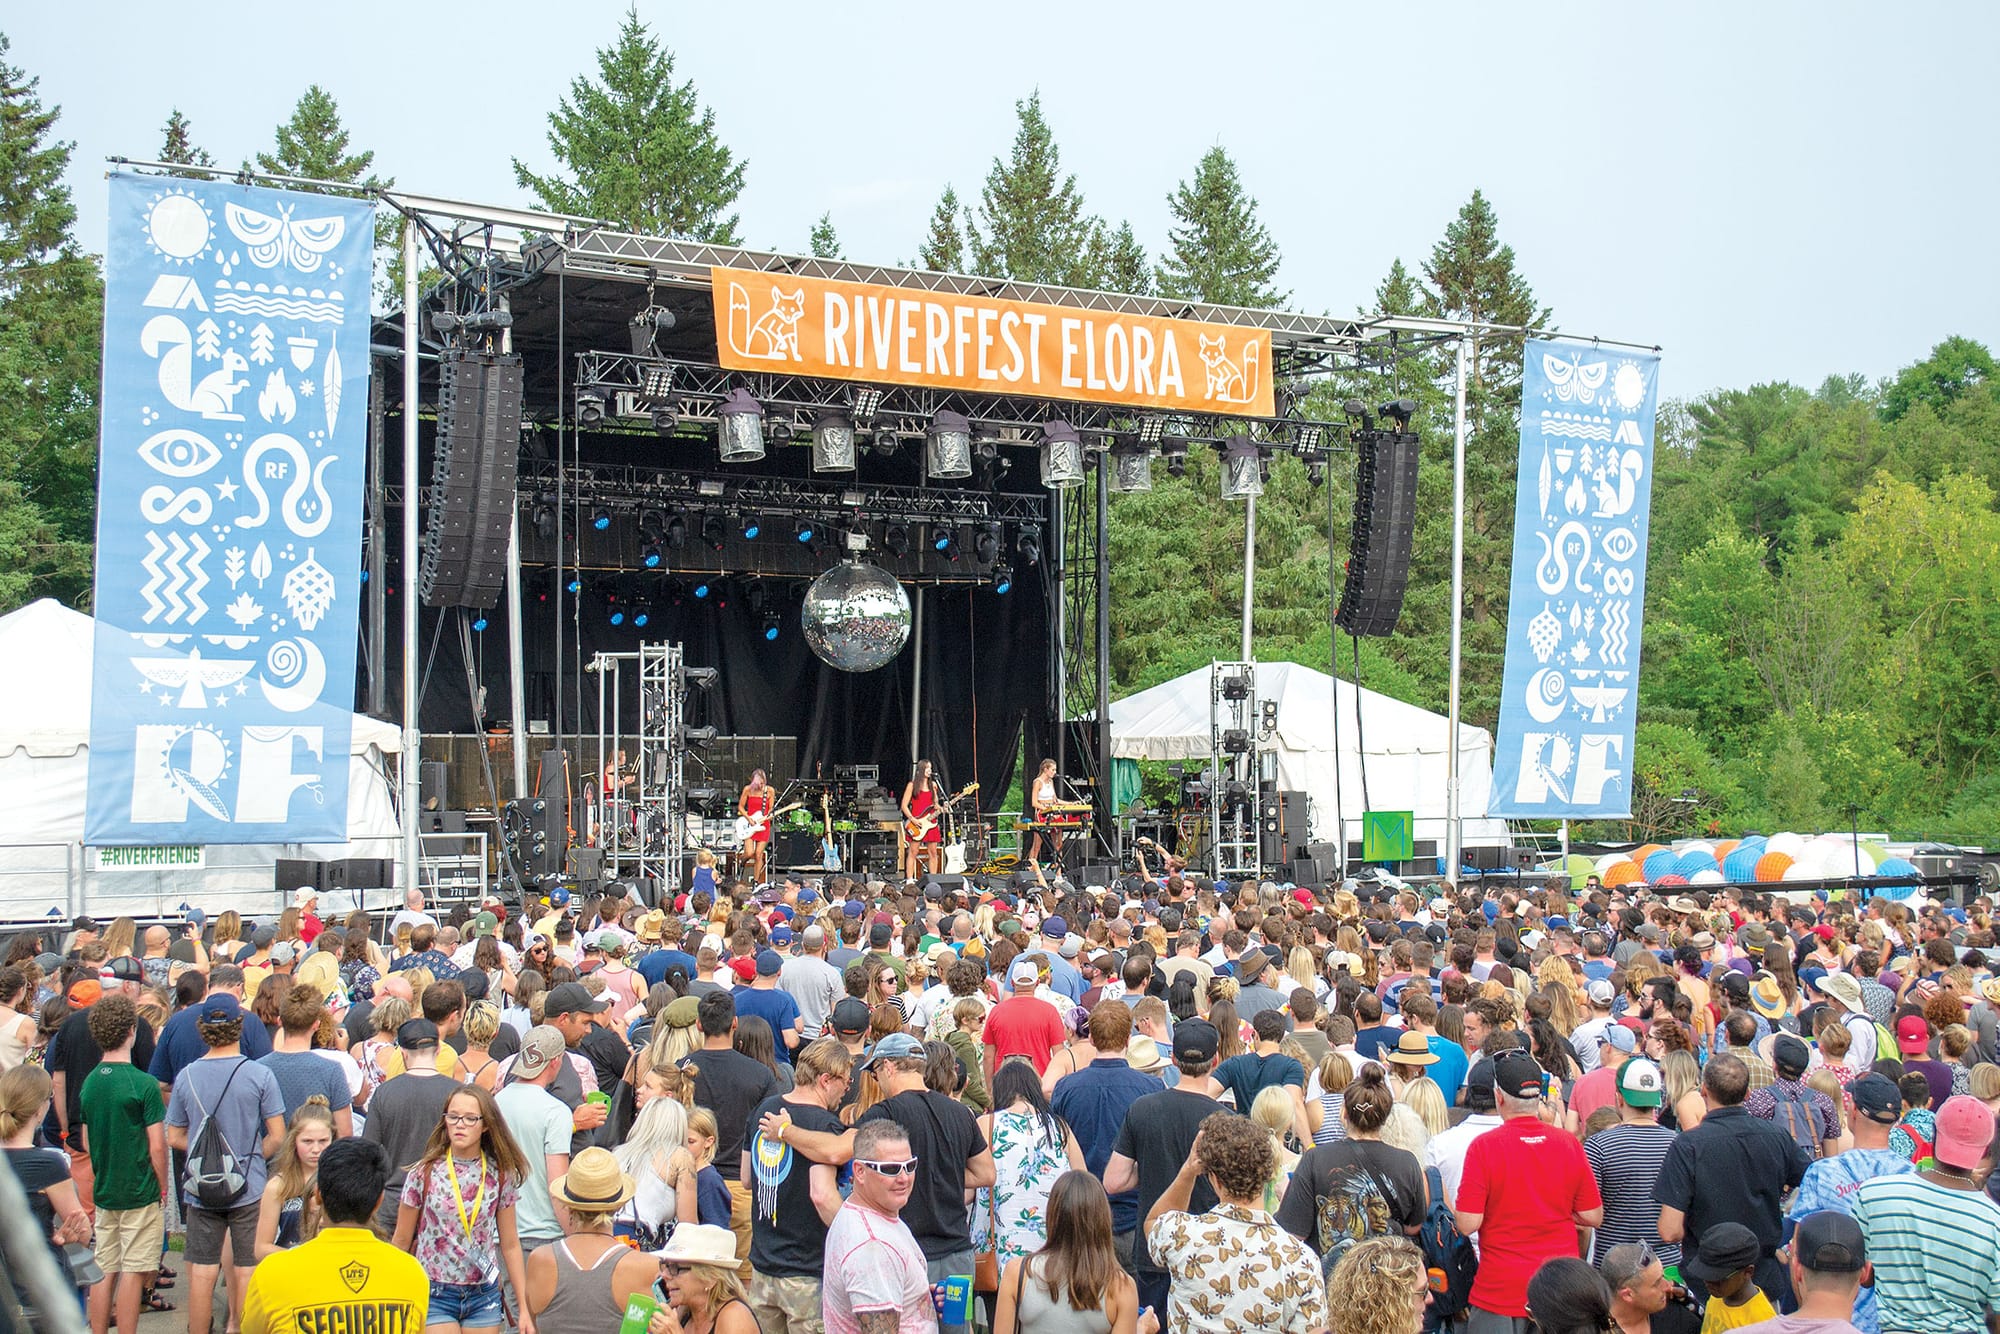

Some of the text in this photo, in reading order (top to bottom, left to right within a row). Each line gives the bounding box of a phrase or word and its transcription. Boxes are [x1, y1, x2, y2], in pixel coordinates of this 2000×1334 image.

[824, 292, 1185, 398] RIVERFEST ELORA
[264, 461, 289, 479] RF
[1567, 542, 1581, 555] RF
[100, 846, 200, 866] #RIVERFRIENDS
[297, 1303, 411, 1334] SECURITY
